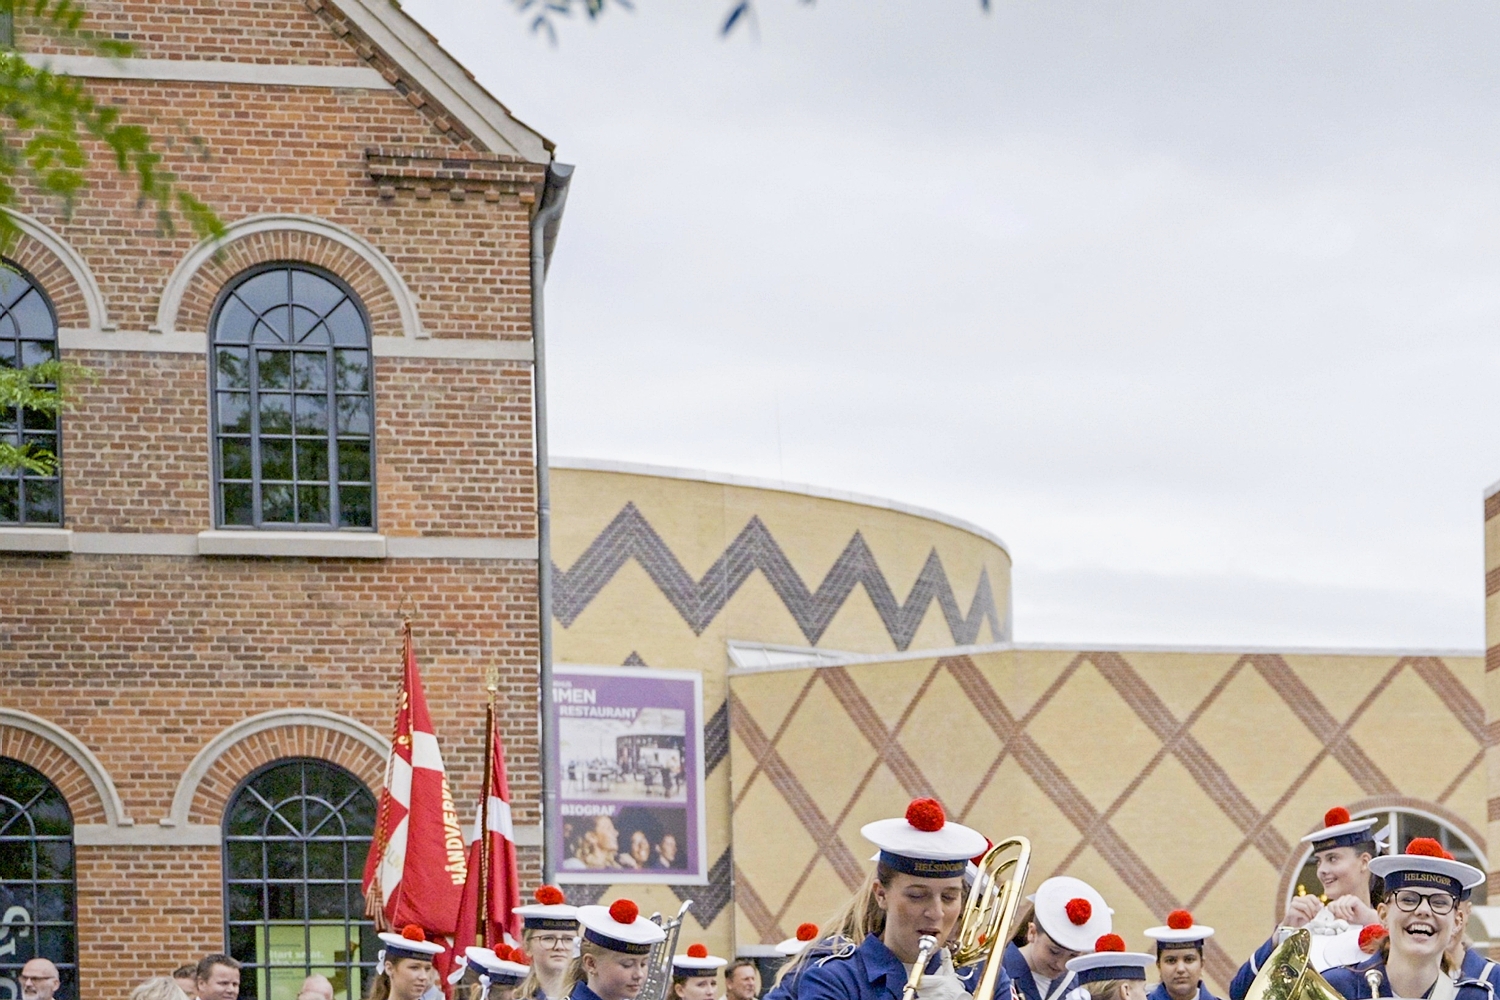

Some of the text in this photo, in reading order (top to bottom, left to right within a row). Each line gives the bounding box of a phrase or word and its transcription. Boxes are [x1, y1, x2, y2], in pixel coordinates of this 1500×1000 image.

[559, 705, 638, 719] RESTAURANT
[560, 804, 616, 816] BIOGRAF
[1404, 872, 1452, 887] HELSINGØR
